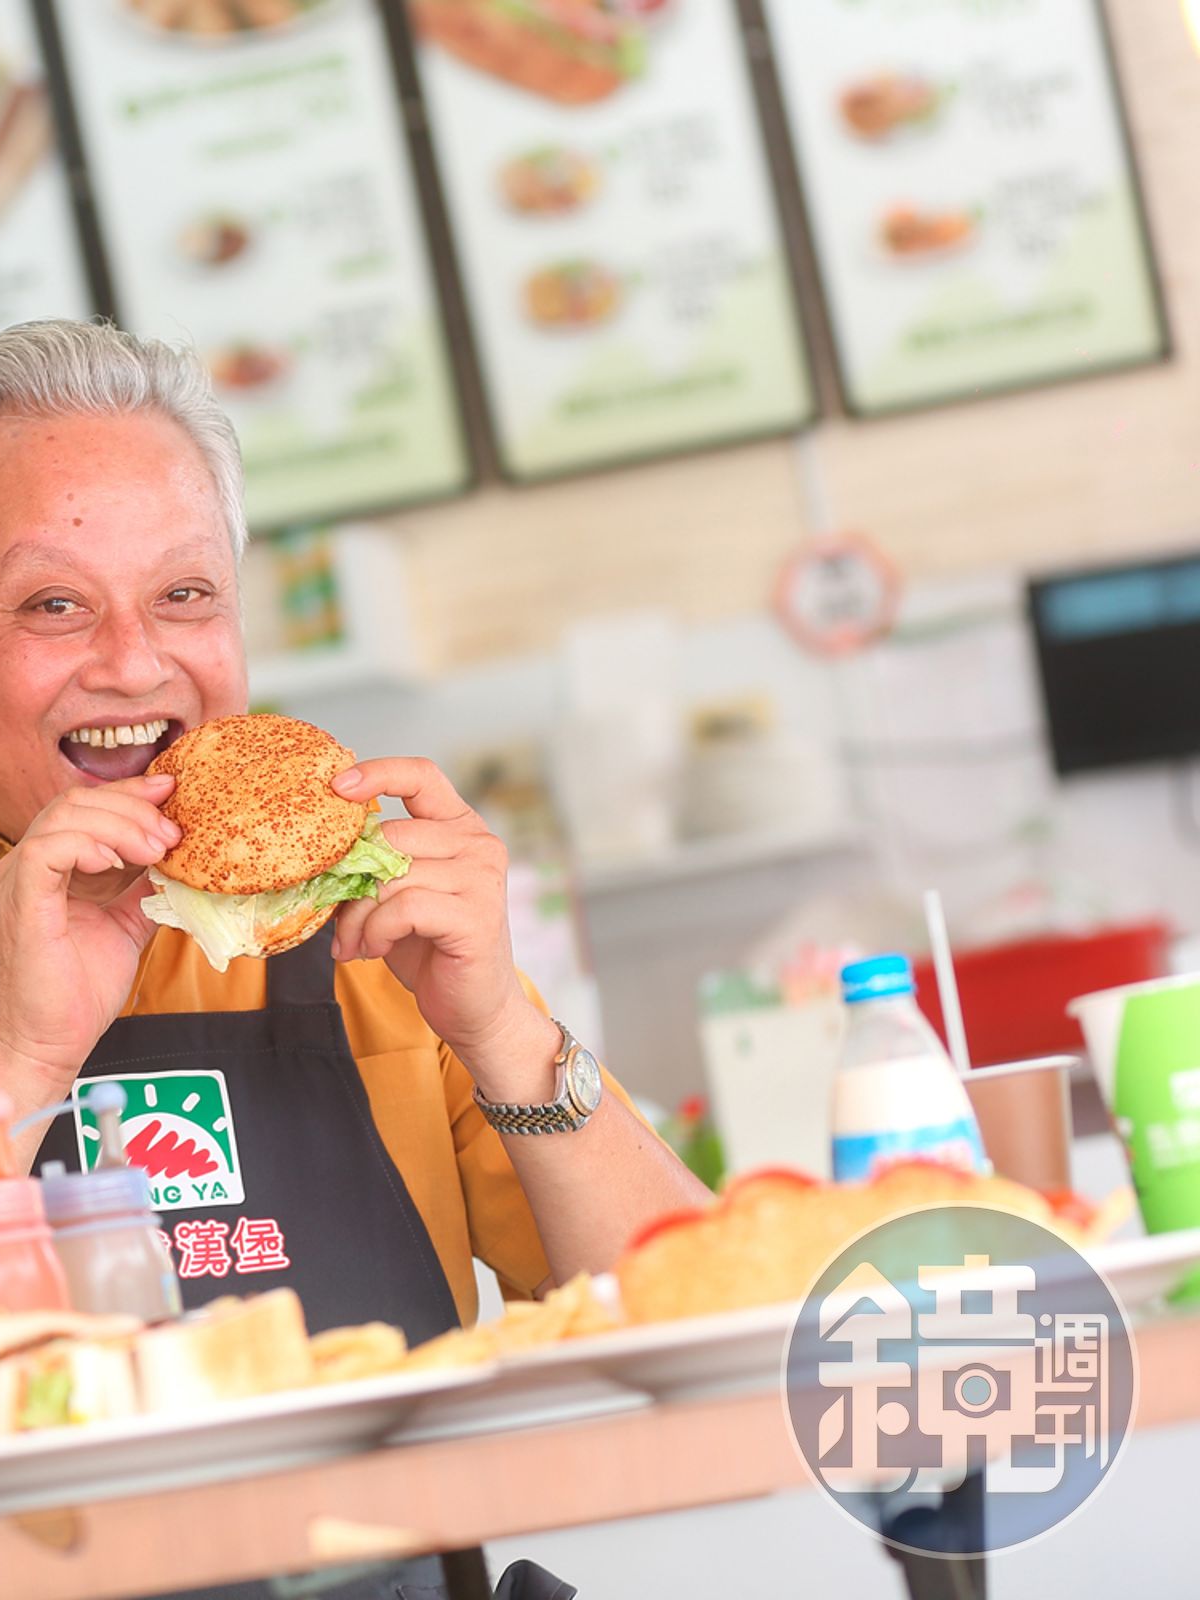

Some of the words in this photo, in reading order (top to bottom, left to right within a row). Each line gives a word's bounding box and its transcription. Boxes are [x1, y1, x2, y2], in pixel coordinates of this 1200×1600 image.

[150, 1185, 182, 1205] NG
[191, 1181, 228, 1201] YA
[157, 1216, 291, 1279] 漢堡
